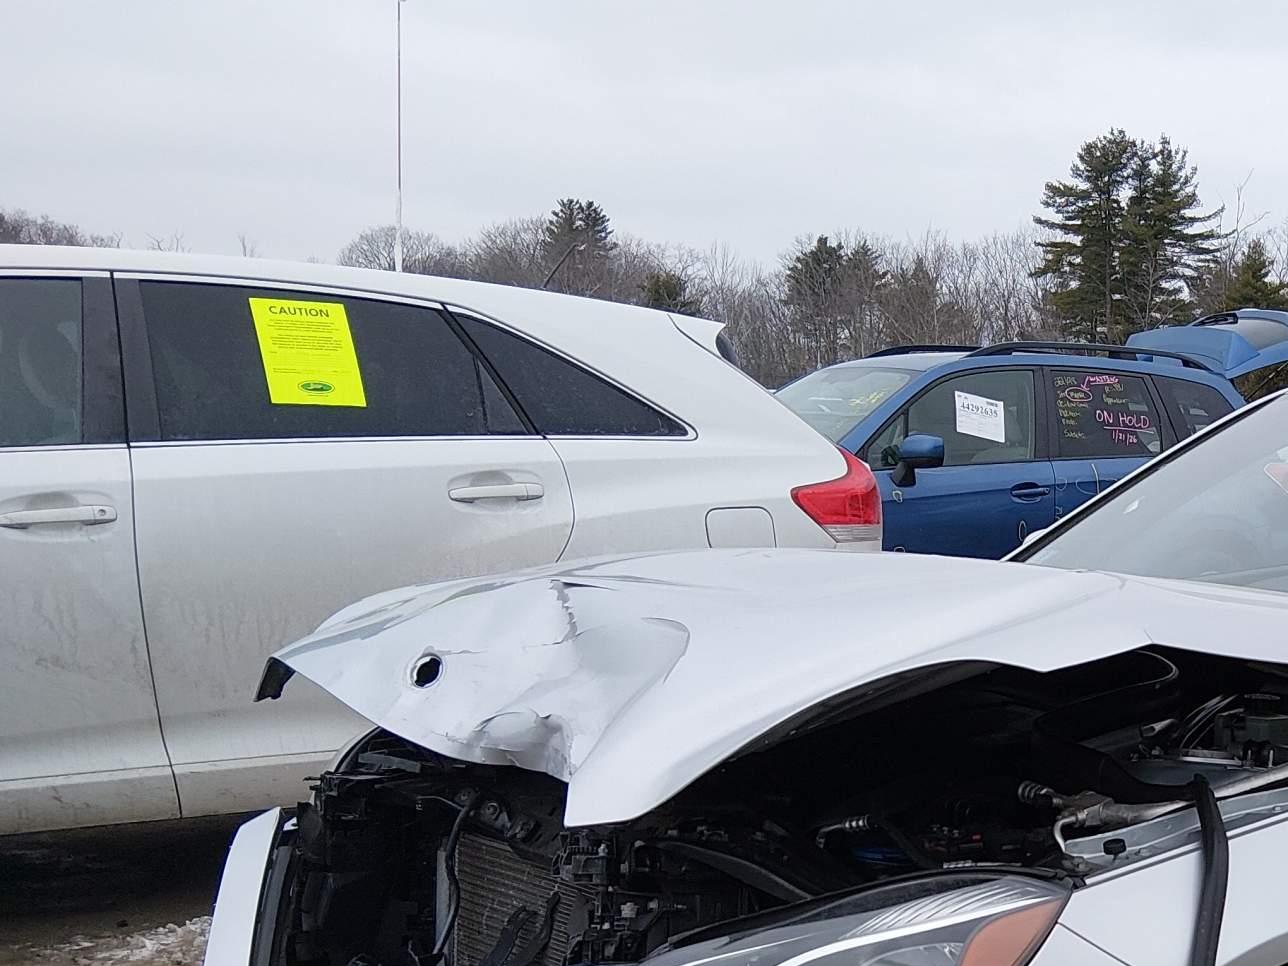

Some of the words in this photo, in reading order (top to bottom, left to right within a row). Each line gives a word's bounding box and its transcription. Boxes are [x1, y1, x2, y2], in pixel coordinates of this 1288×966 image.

[268, 305, 330, 318] CAUTION
[1096, 410, 1113, 424] ON
[1119, 412, 1150, 428] HOLD
